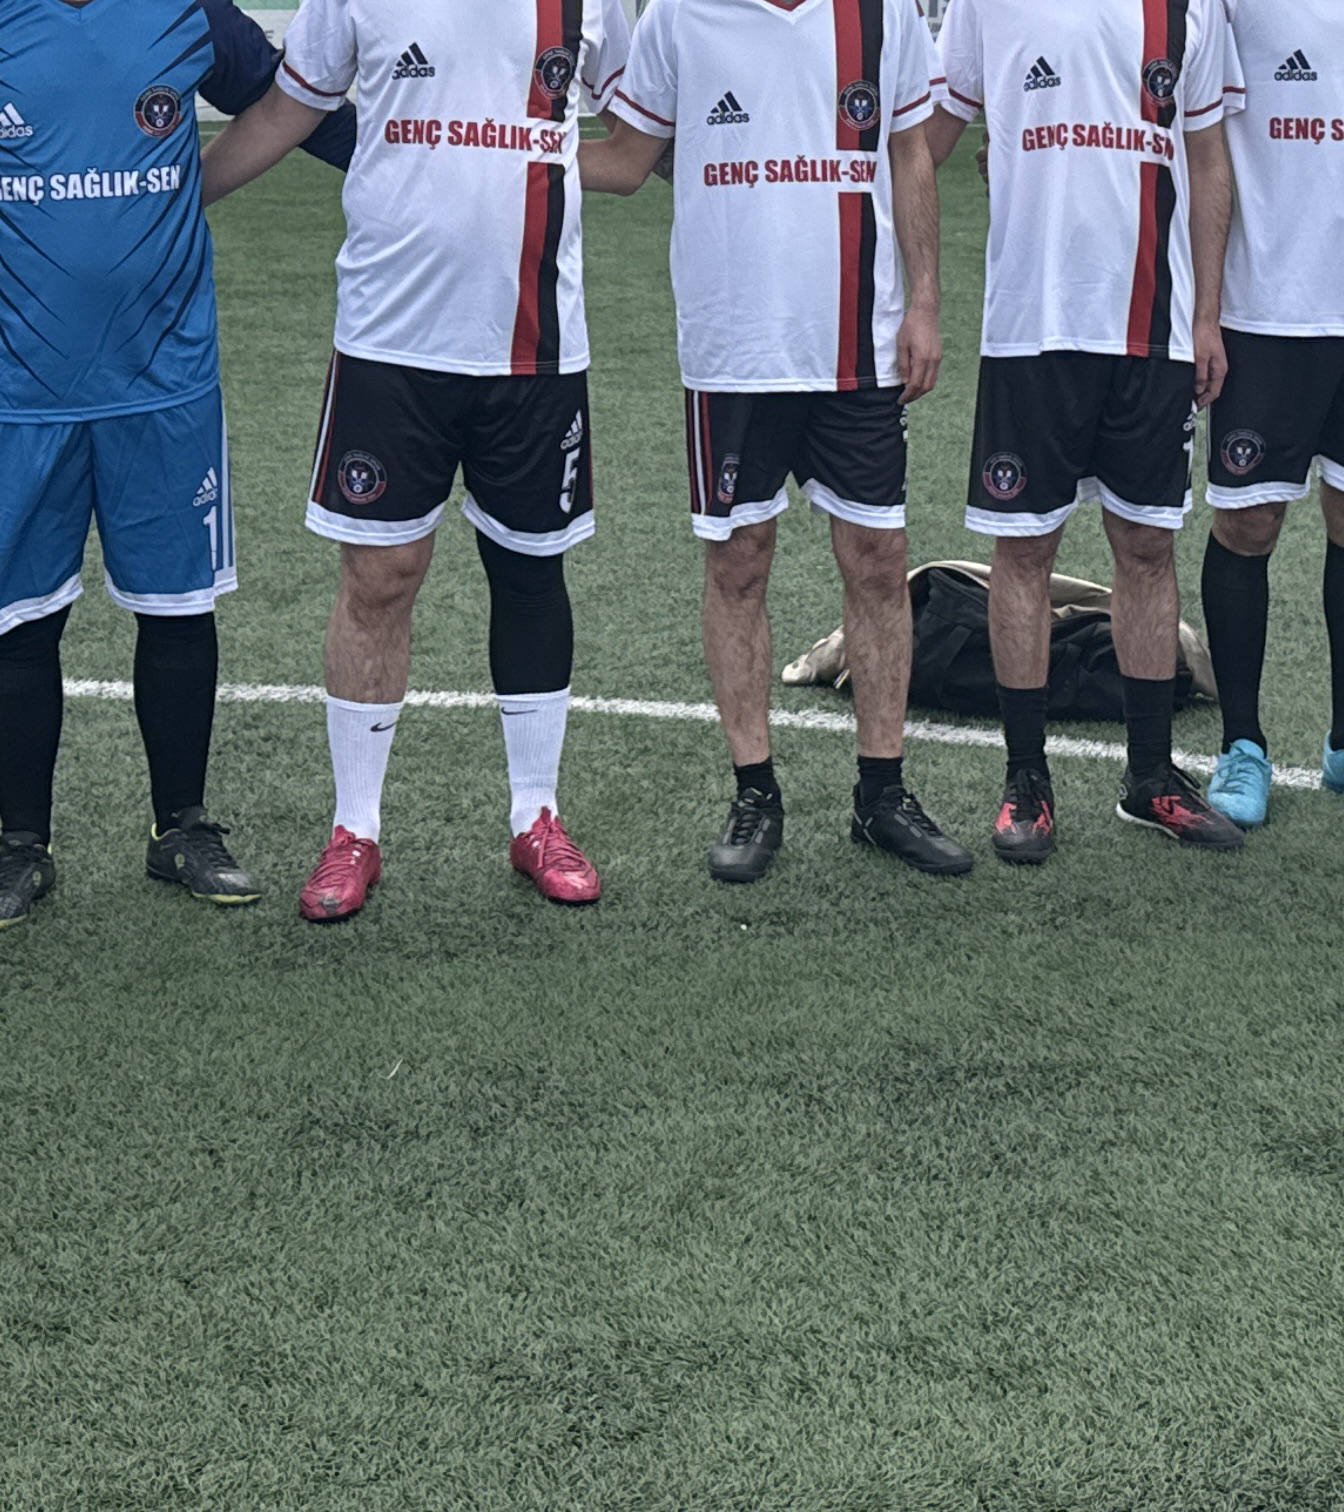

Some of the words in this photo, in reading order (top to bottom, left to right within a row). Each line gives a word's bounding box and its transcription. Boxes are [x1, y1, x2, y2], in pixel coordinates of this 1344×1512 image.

[1274, 69, 1318, 82] adidas
[384, 118, 442, 151] GENÇ
[706, 110, 750, 126] adidas
[1269, 116, 1326, 145] GENÇ
[1022, 122, 1069, 152] GENÇ
[50, 164, 181, 201] SAĞLIK-SEN
[703, 160, 759, 189] GENÇ
[764, 153, 878, 184] SAĞLIK-SEN
[559, 445, 582, 514] 5
[202, 505, 218, 572] 1
